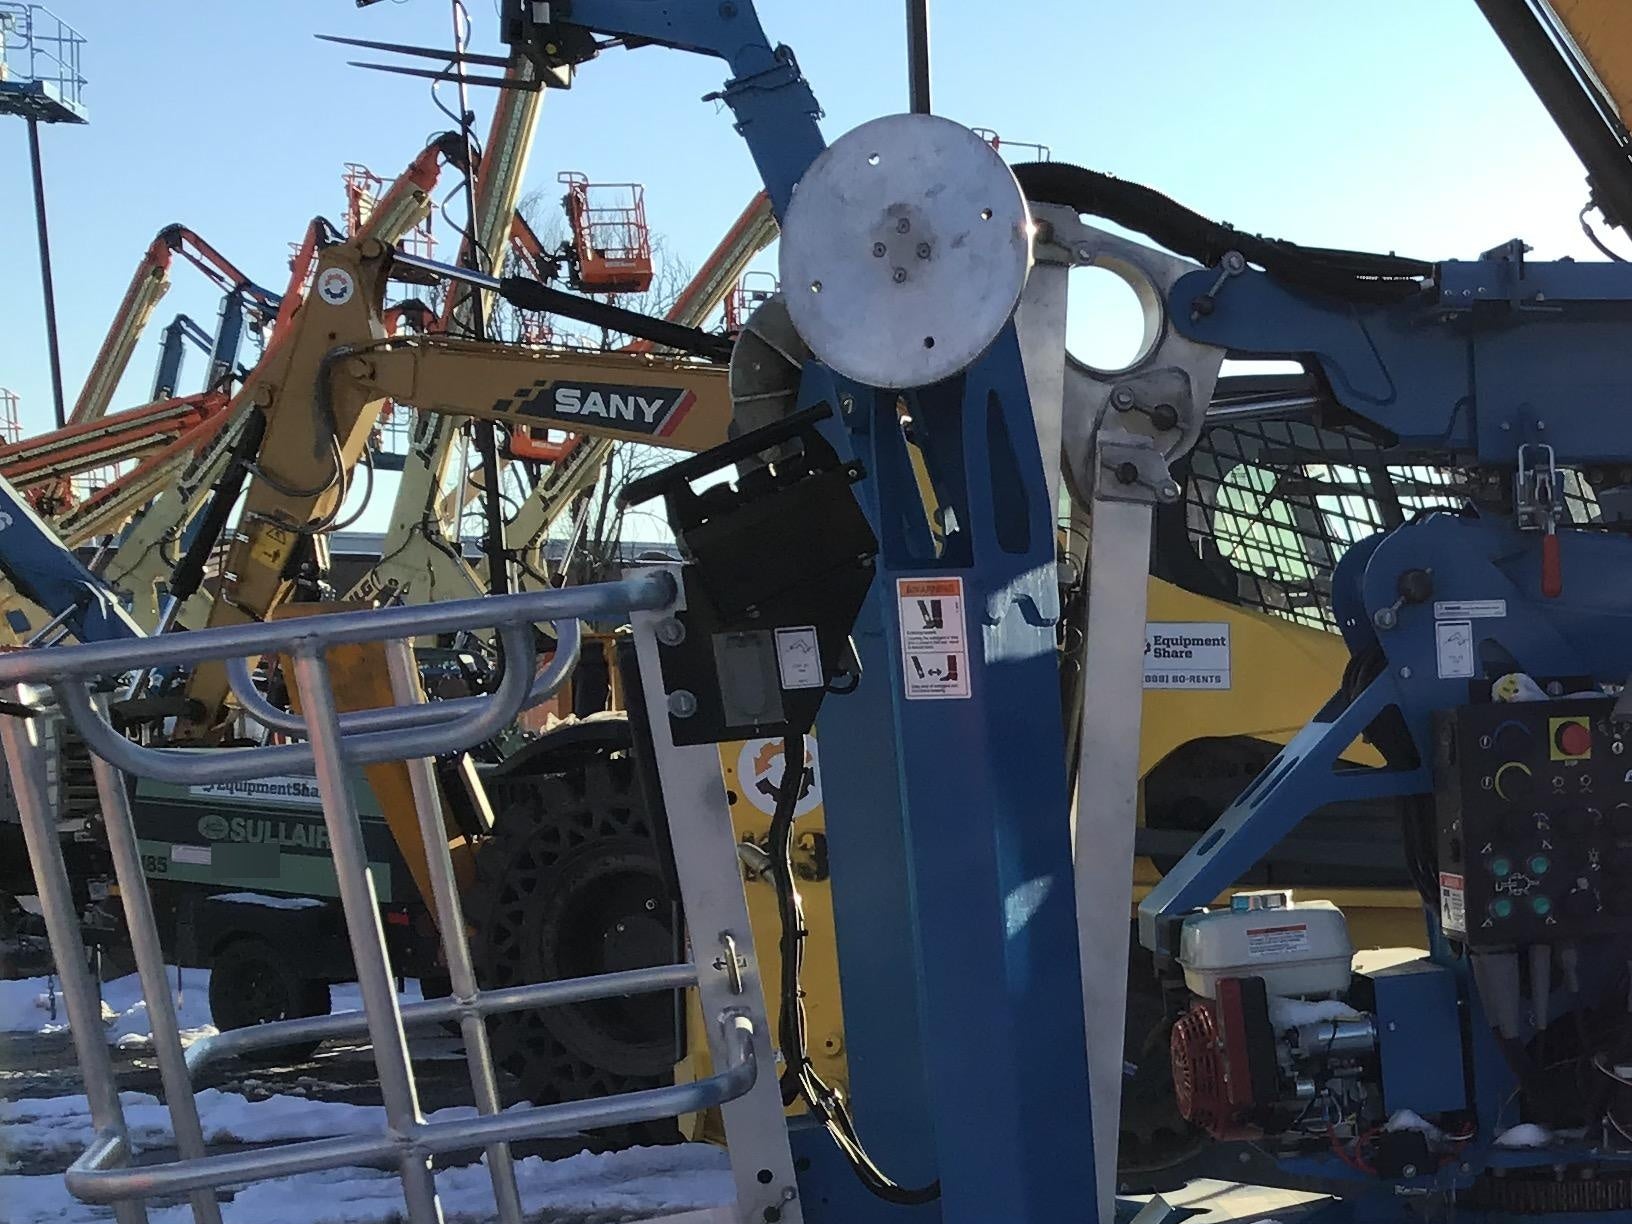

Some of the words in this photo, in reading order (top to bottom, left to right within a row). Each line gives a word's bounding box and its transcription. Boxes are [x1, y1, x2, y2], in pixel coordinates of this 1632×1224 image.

[555, 388, 664, 423] SANY
[1153, 635, 1226, 648] Equipment
[1153, 648, 1192, 658] Share
[231, 818, 330, 848] SULLAIR
